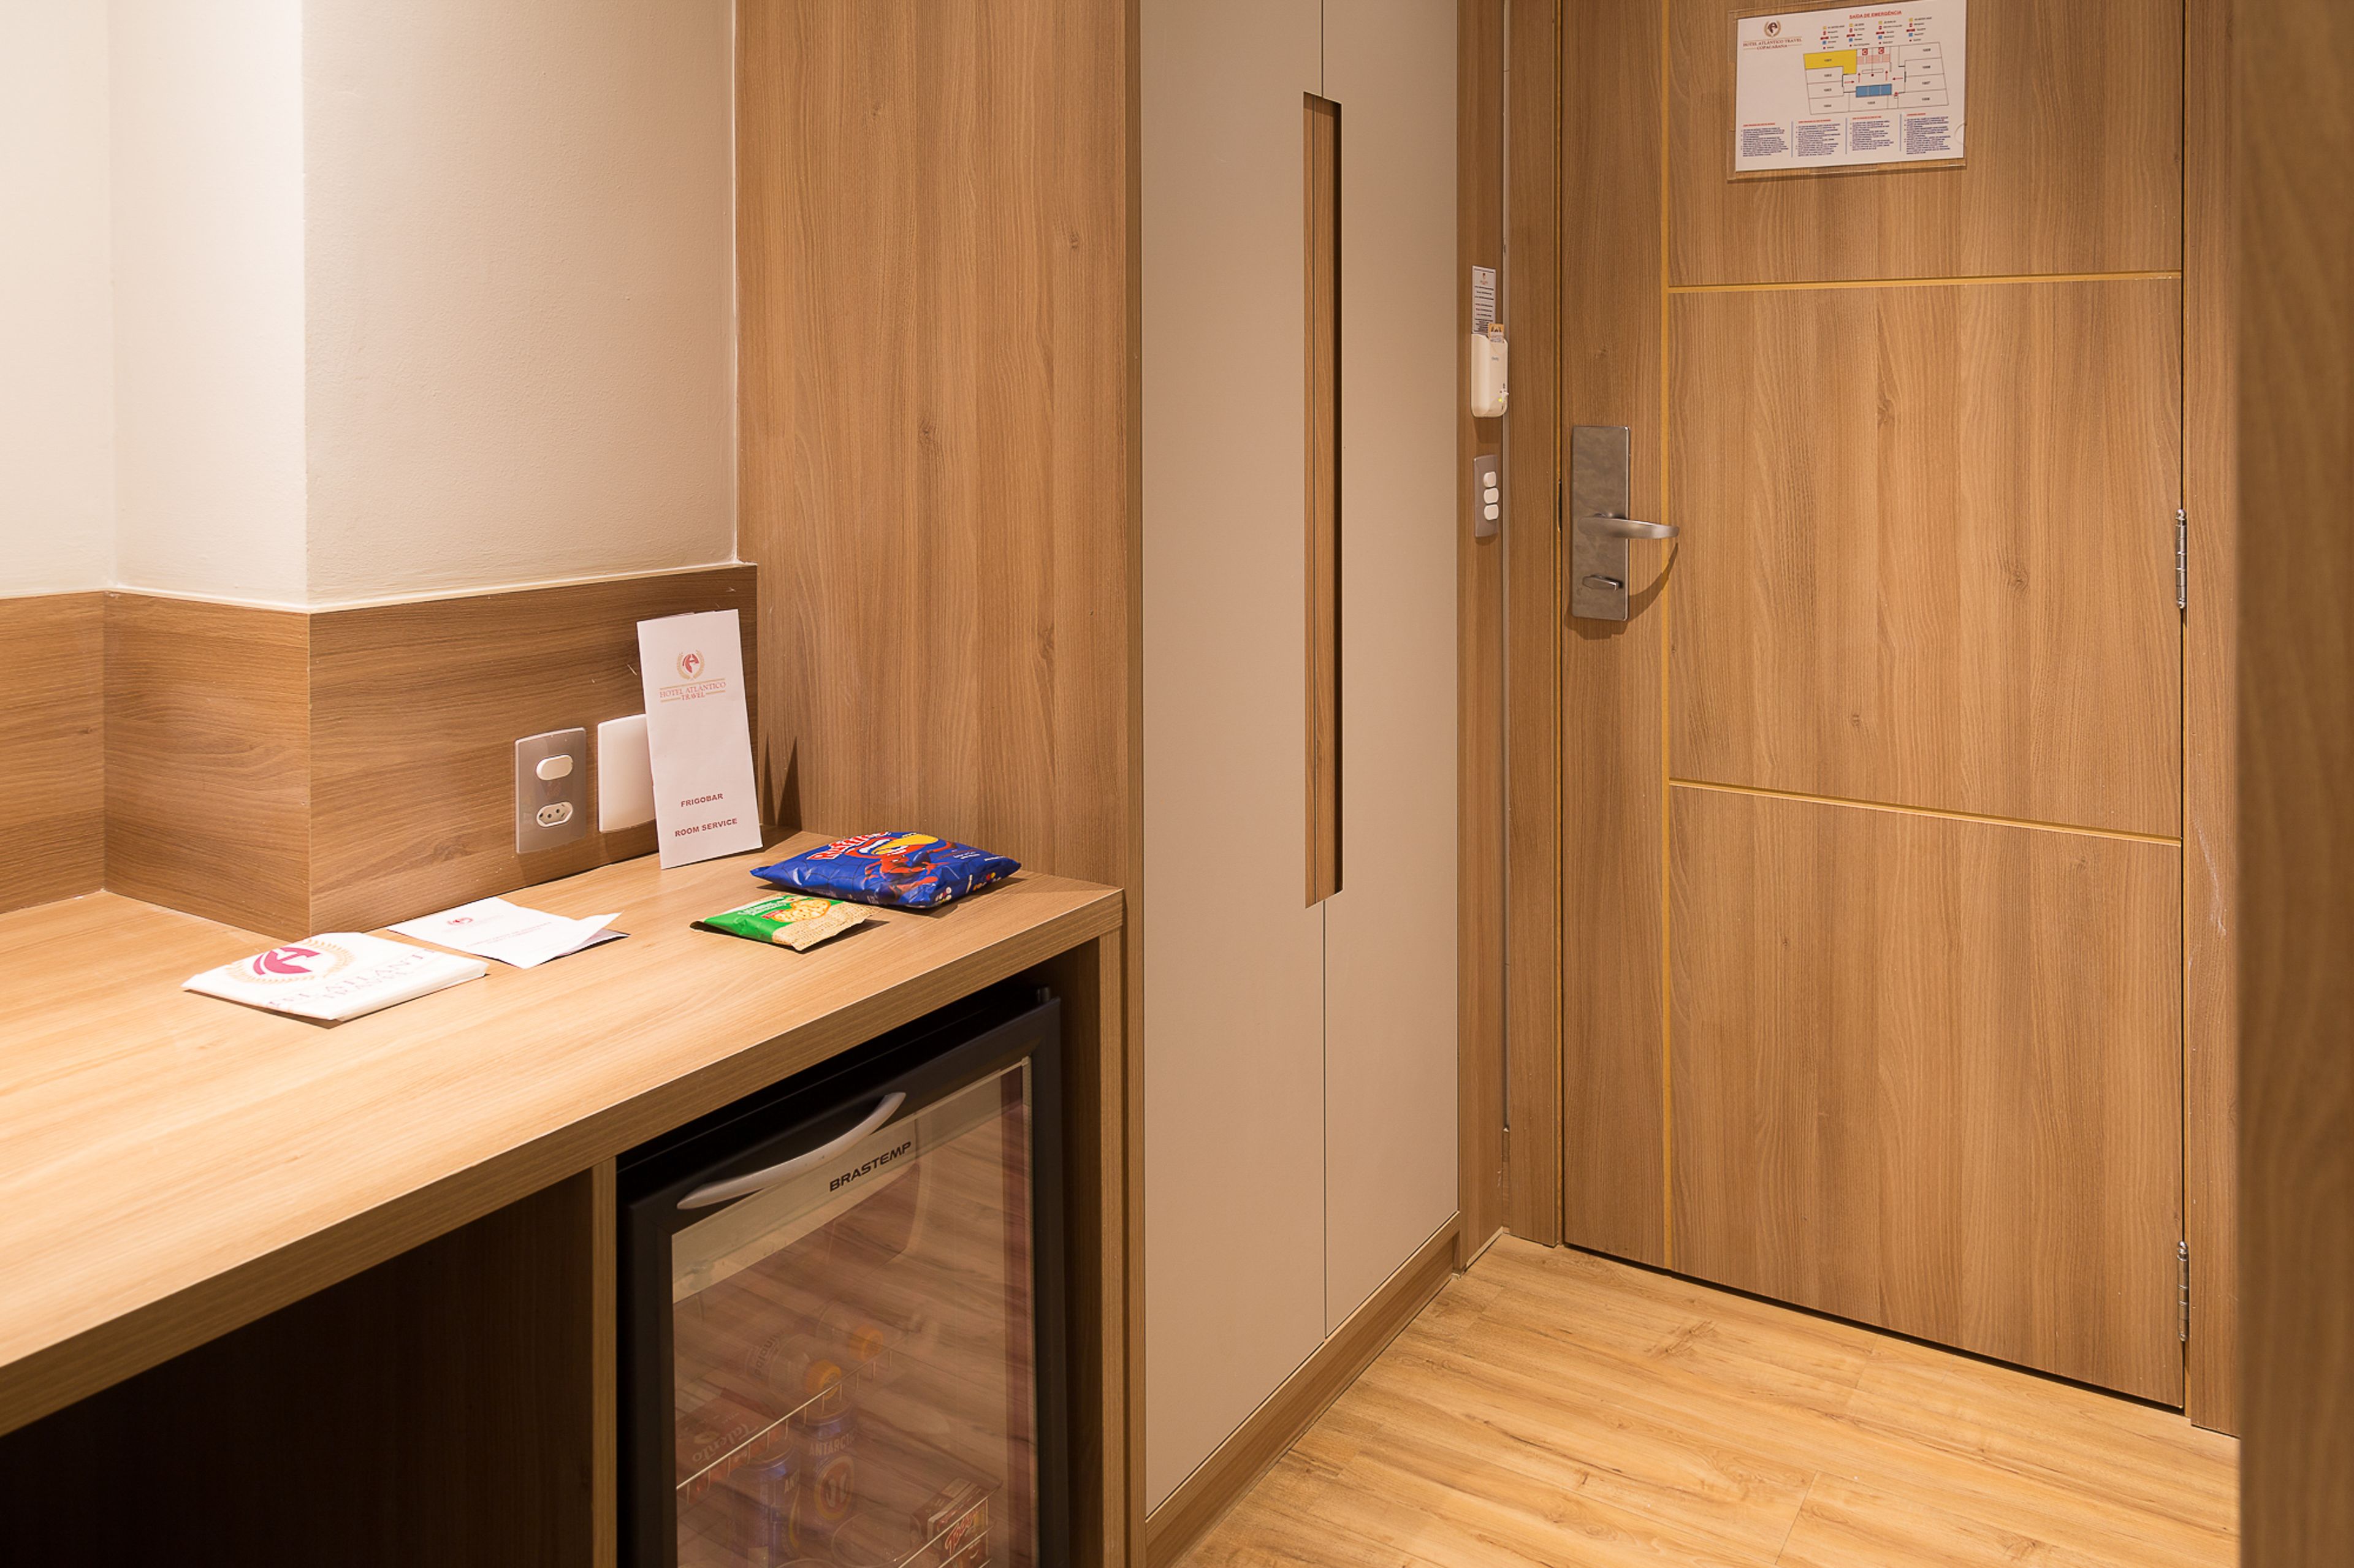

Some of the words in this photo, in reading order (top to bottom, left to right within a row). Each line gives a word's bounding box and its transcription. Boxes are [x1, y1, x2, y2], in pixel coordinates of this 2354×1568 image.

[659, 688, 683, 698] HOTEL
[680, 691, 706, 701] TRAVEL
[680, 793, 723, 807] FRIGOBAR
[674, 824, 699, 837] ROOM
[702, 818, 737, 832] SERVICE
[829, 1141, 912, 1192] BRASTEMP
[691, 1423, 759, 1463] Talento
